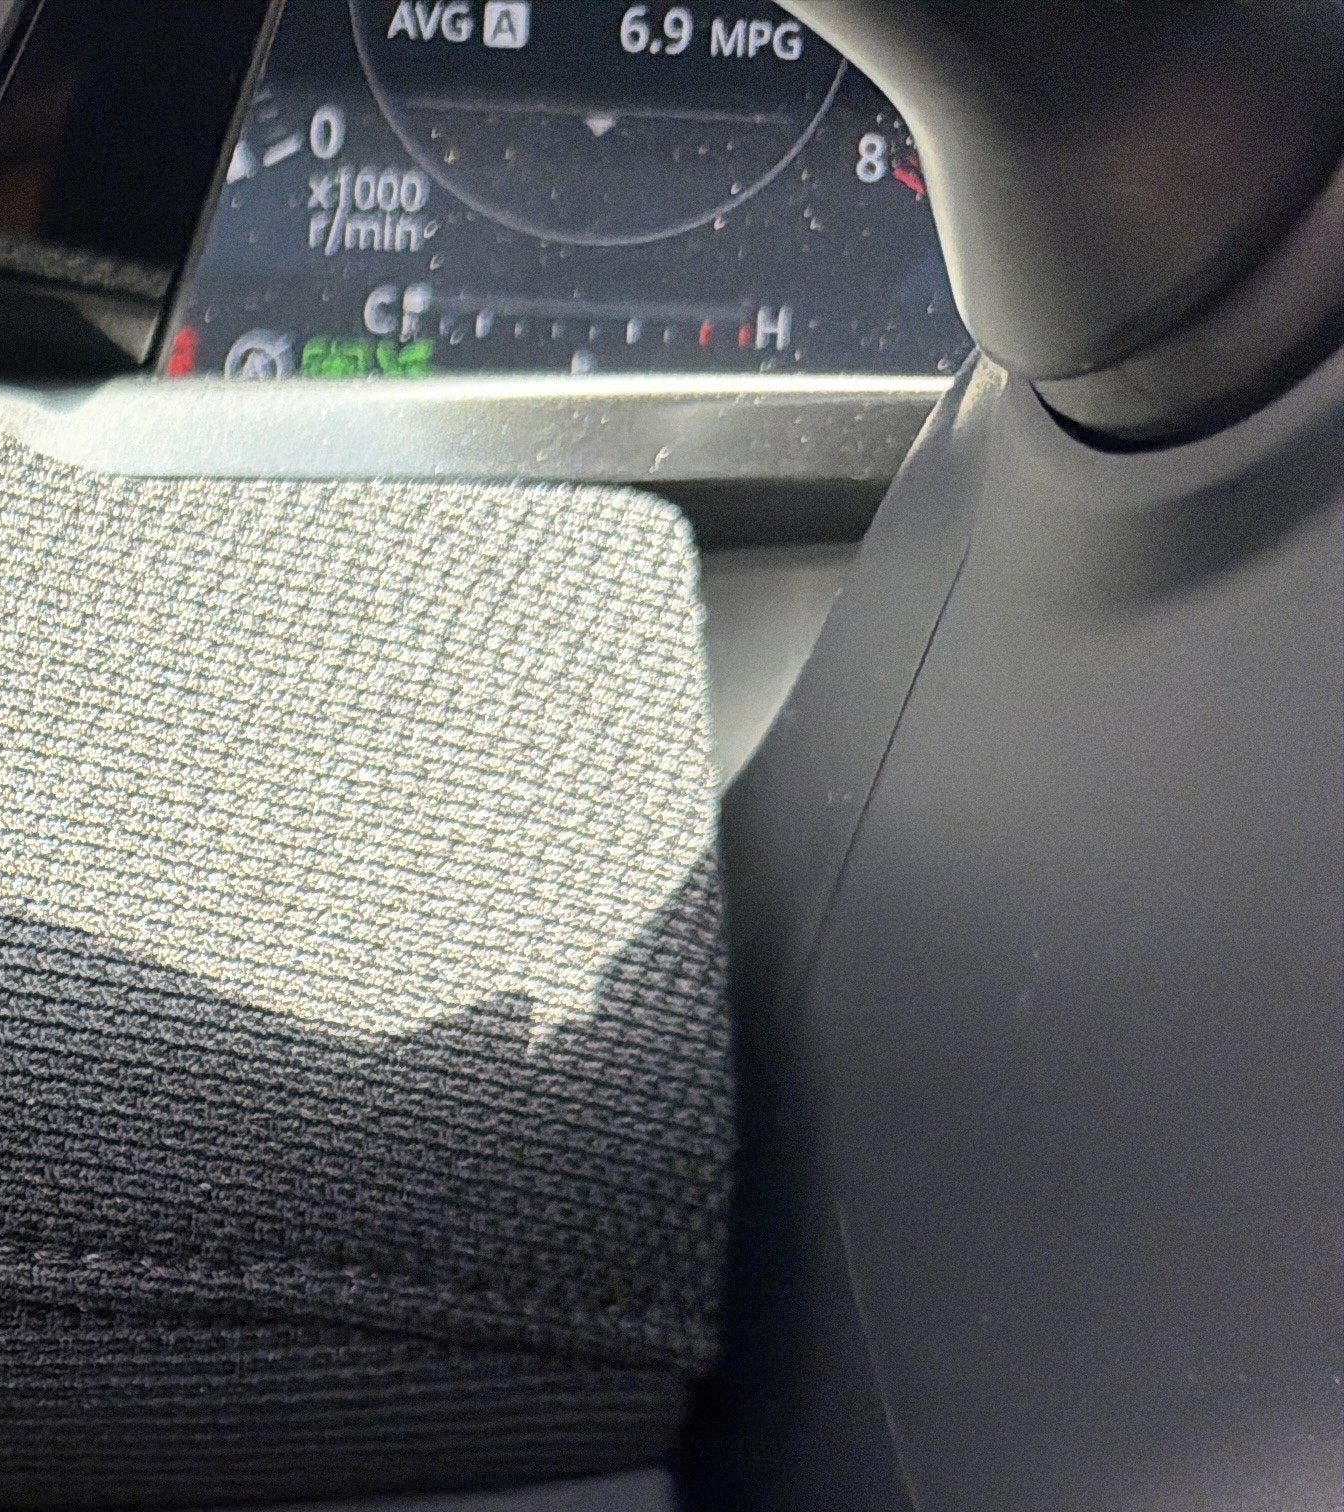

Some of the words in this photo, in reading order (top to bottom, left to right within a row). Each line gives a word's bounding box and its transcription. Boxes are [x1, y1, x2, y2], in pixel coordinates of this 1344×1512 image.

[387, 2, 474, 43] AVG
[619, 6, 694, 56] 6.9
[710, 17, 803, 62] MPG
[310, 104, 346, 160] 0
[855, 132, 889, 184] 8
[308, 211, 421, 256] r/min
[755, 304, 793, 351] H
